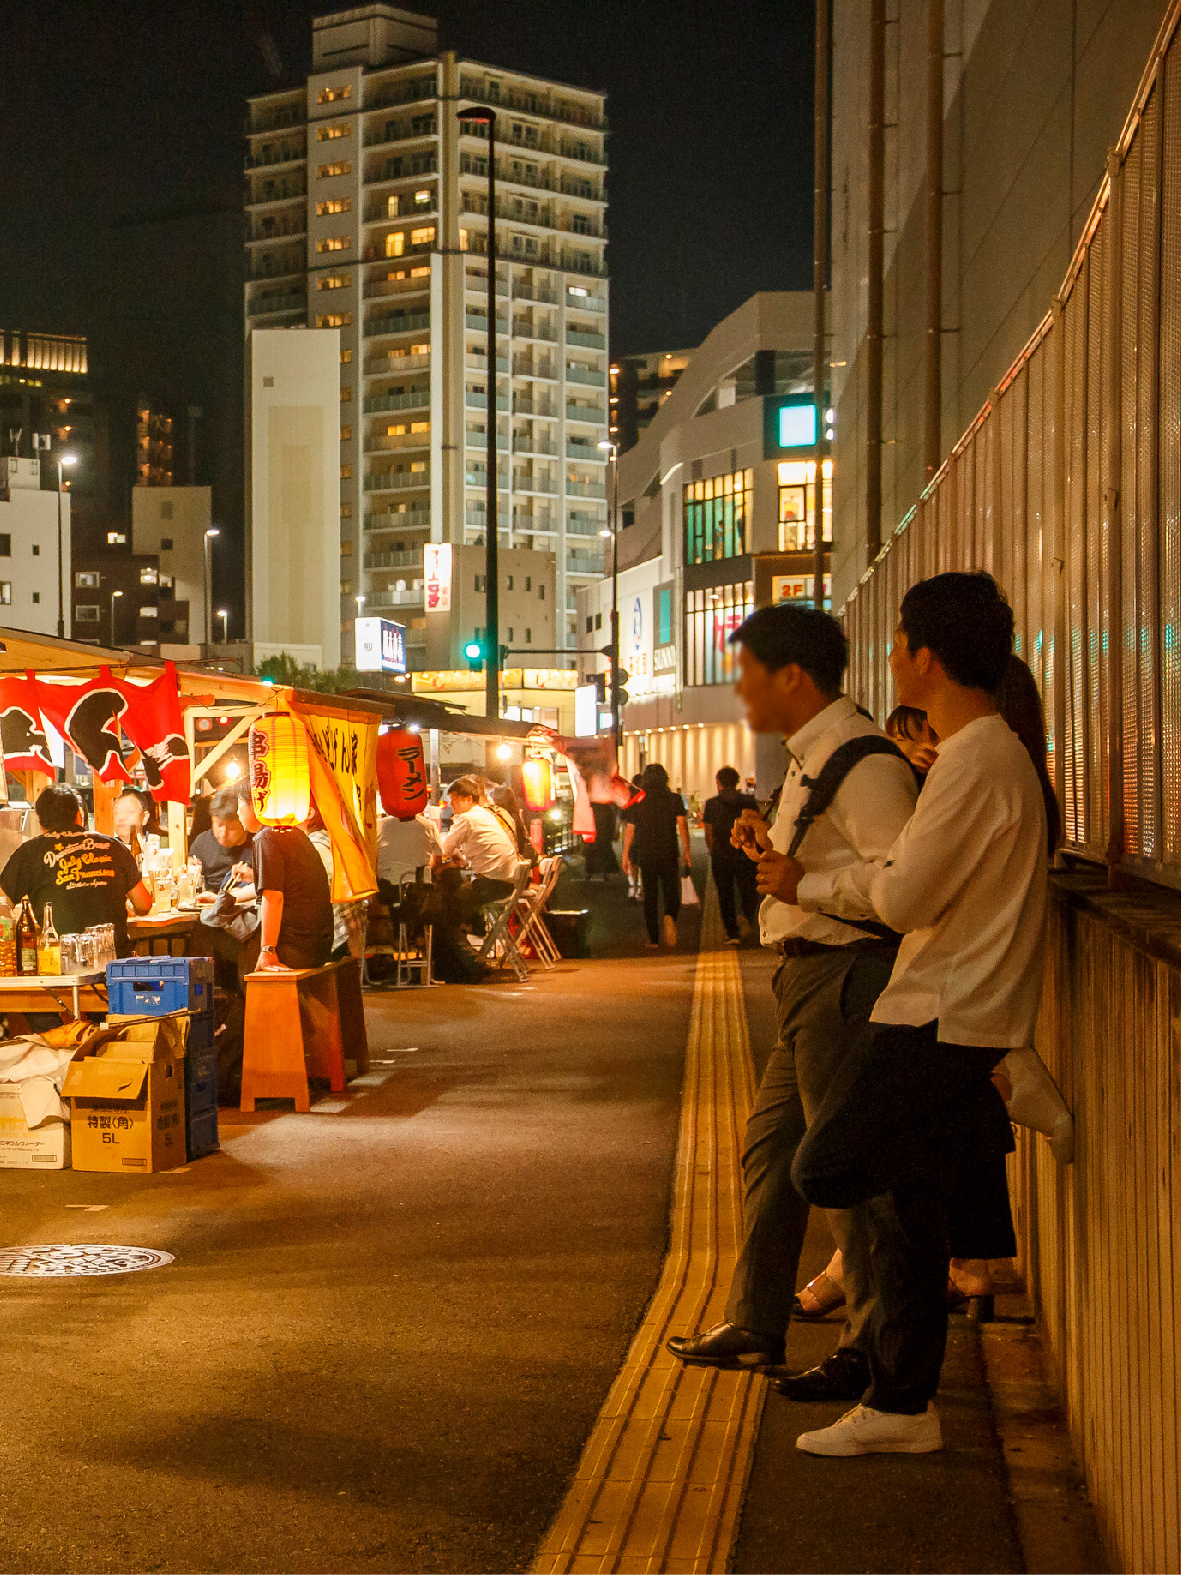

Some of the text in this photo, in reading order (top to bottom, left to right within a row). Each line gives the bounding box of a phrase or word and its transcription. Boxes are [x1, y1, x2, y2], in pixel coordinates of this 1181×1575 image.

[397, 746, 425, 801] ラーメン
[102, 1132, 120, 1144] 5L
